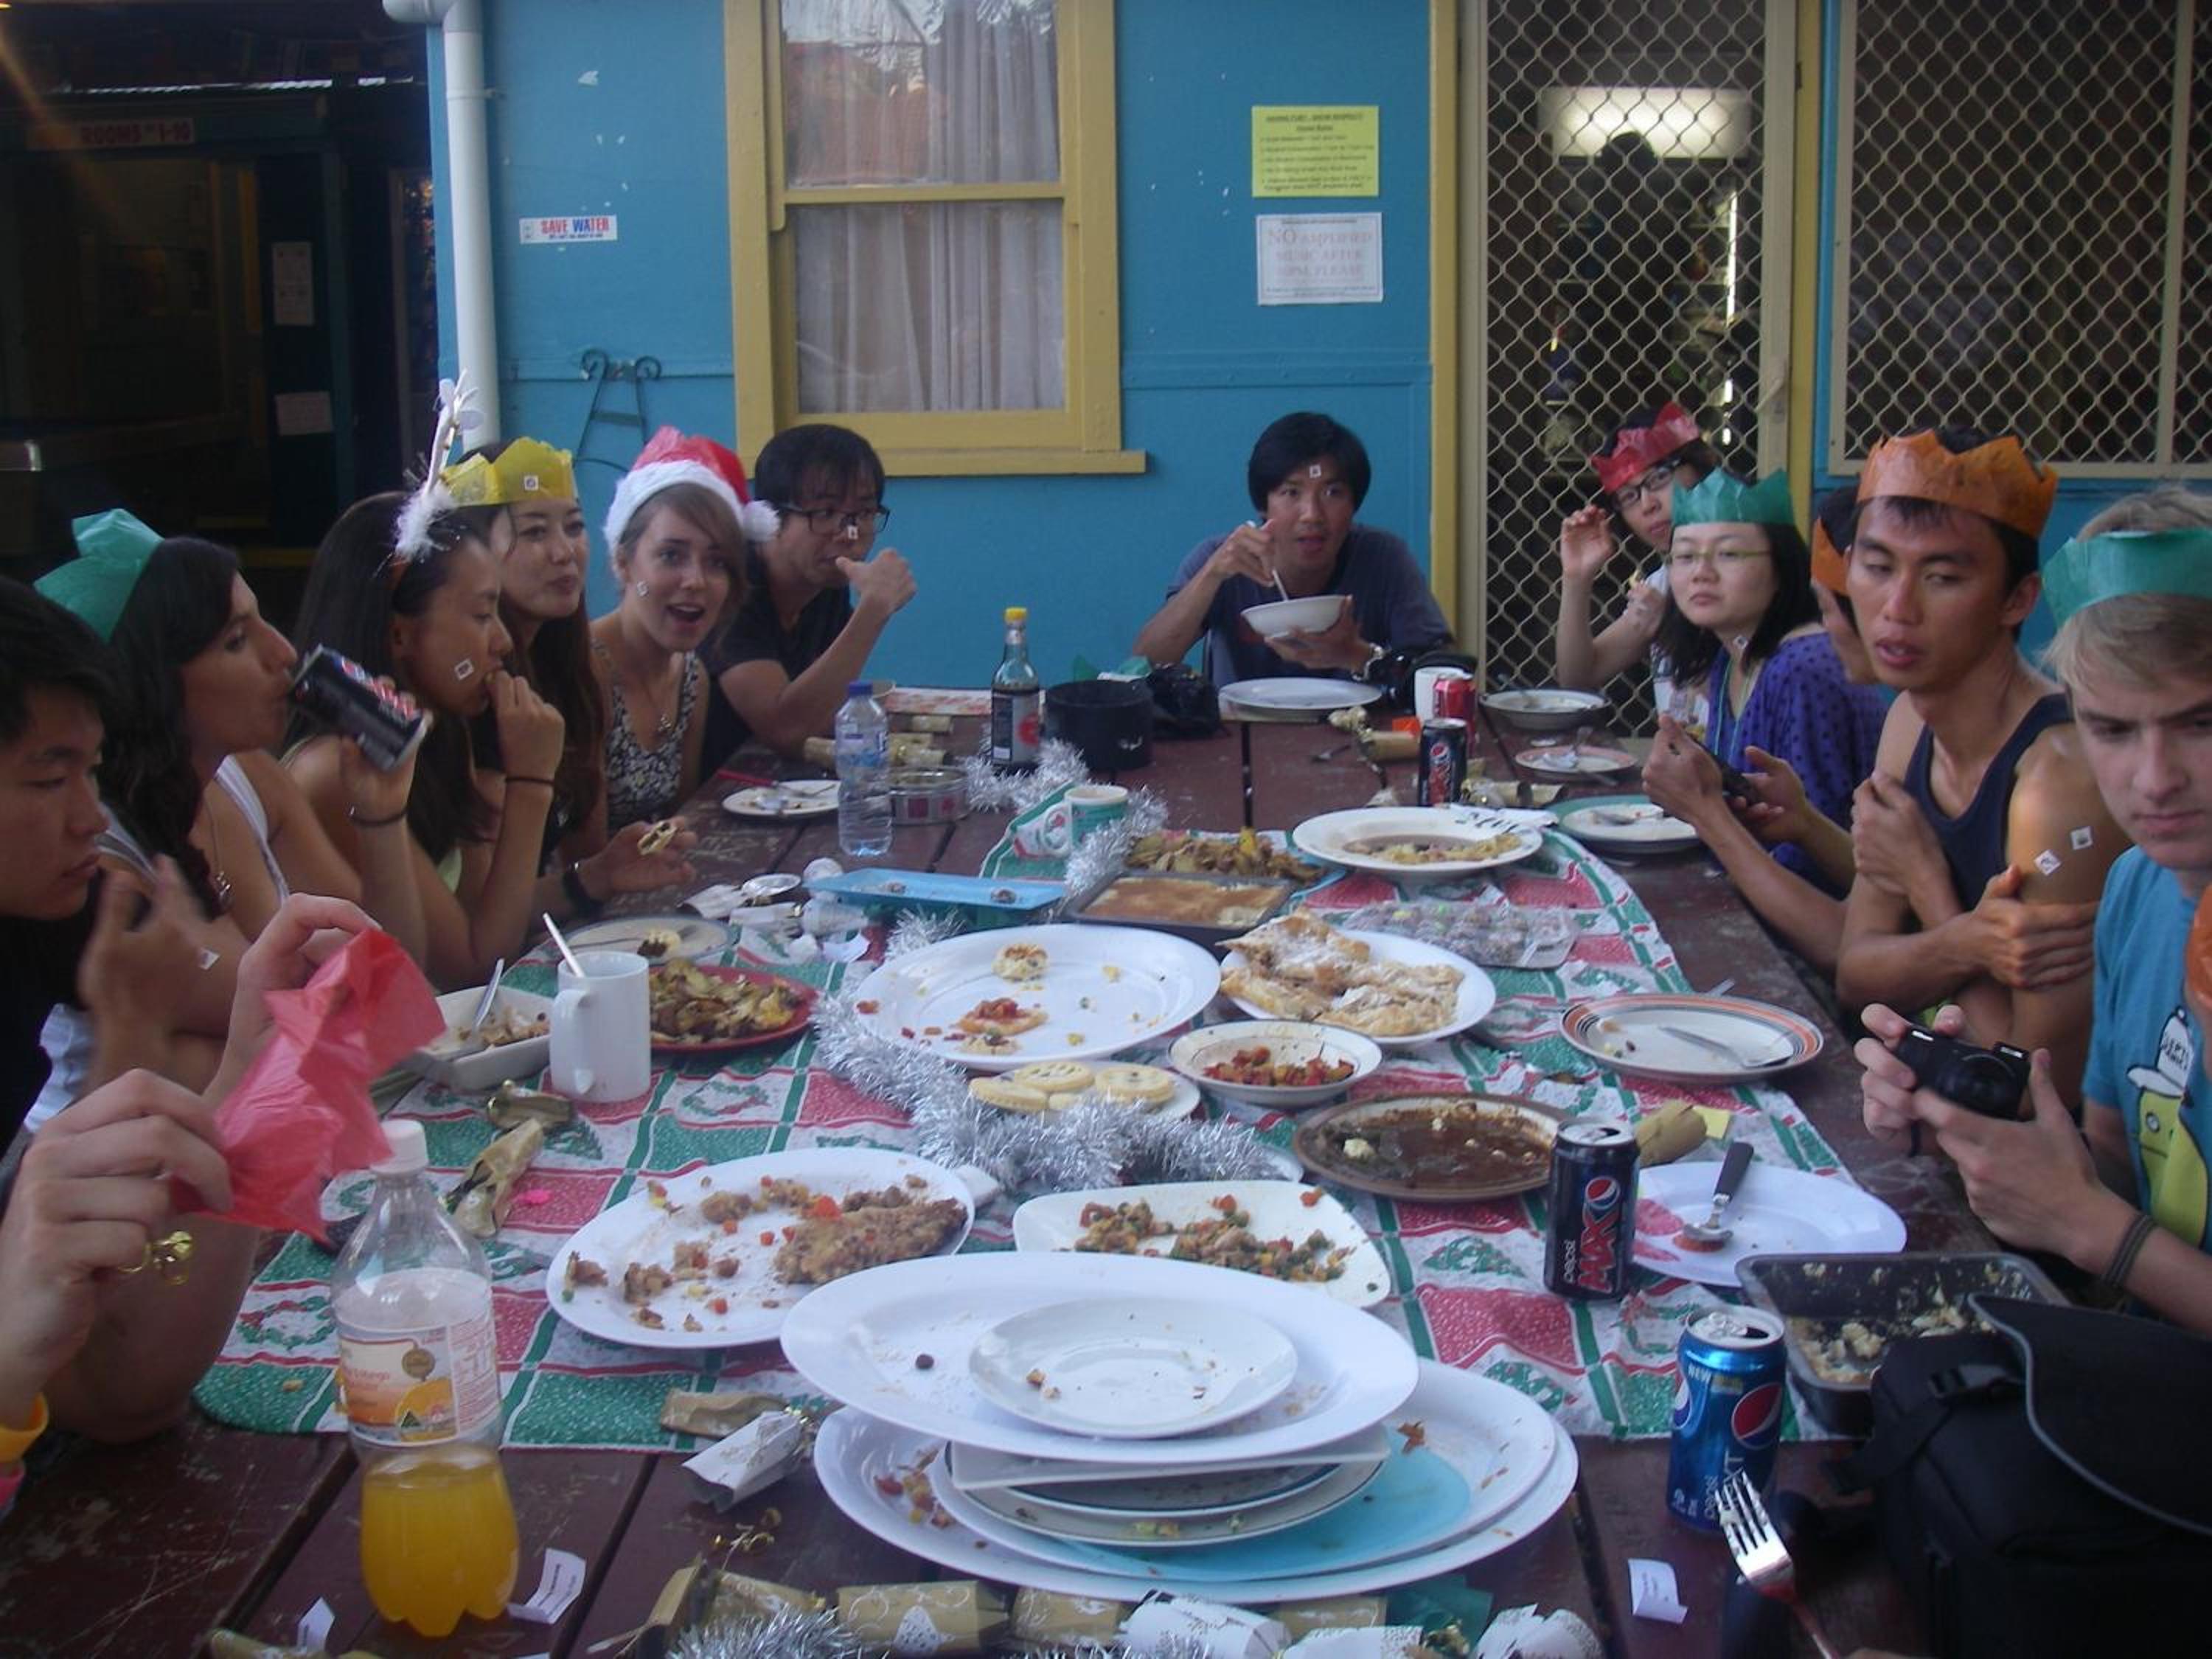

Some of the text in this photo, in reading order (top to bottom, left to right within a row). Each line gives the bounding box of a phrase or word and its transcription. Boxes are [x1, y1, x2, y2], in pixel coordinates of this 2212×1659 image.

[541, 218, 610, 234] SAVE WATER
[1563, 1239, 1576, 1284] pepsi
[1578, 1209, 1620, 1294] MAX
